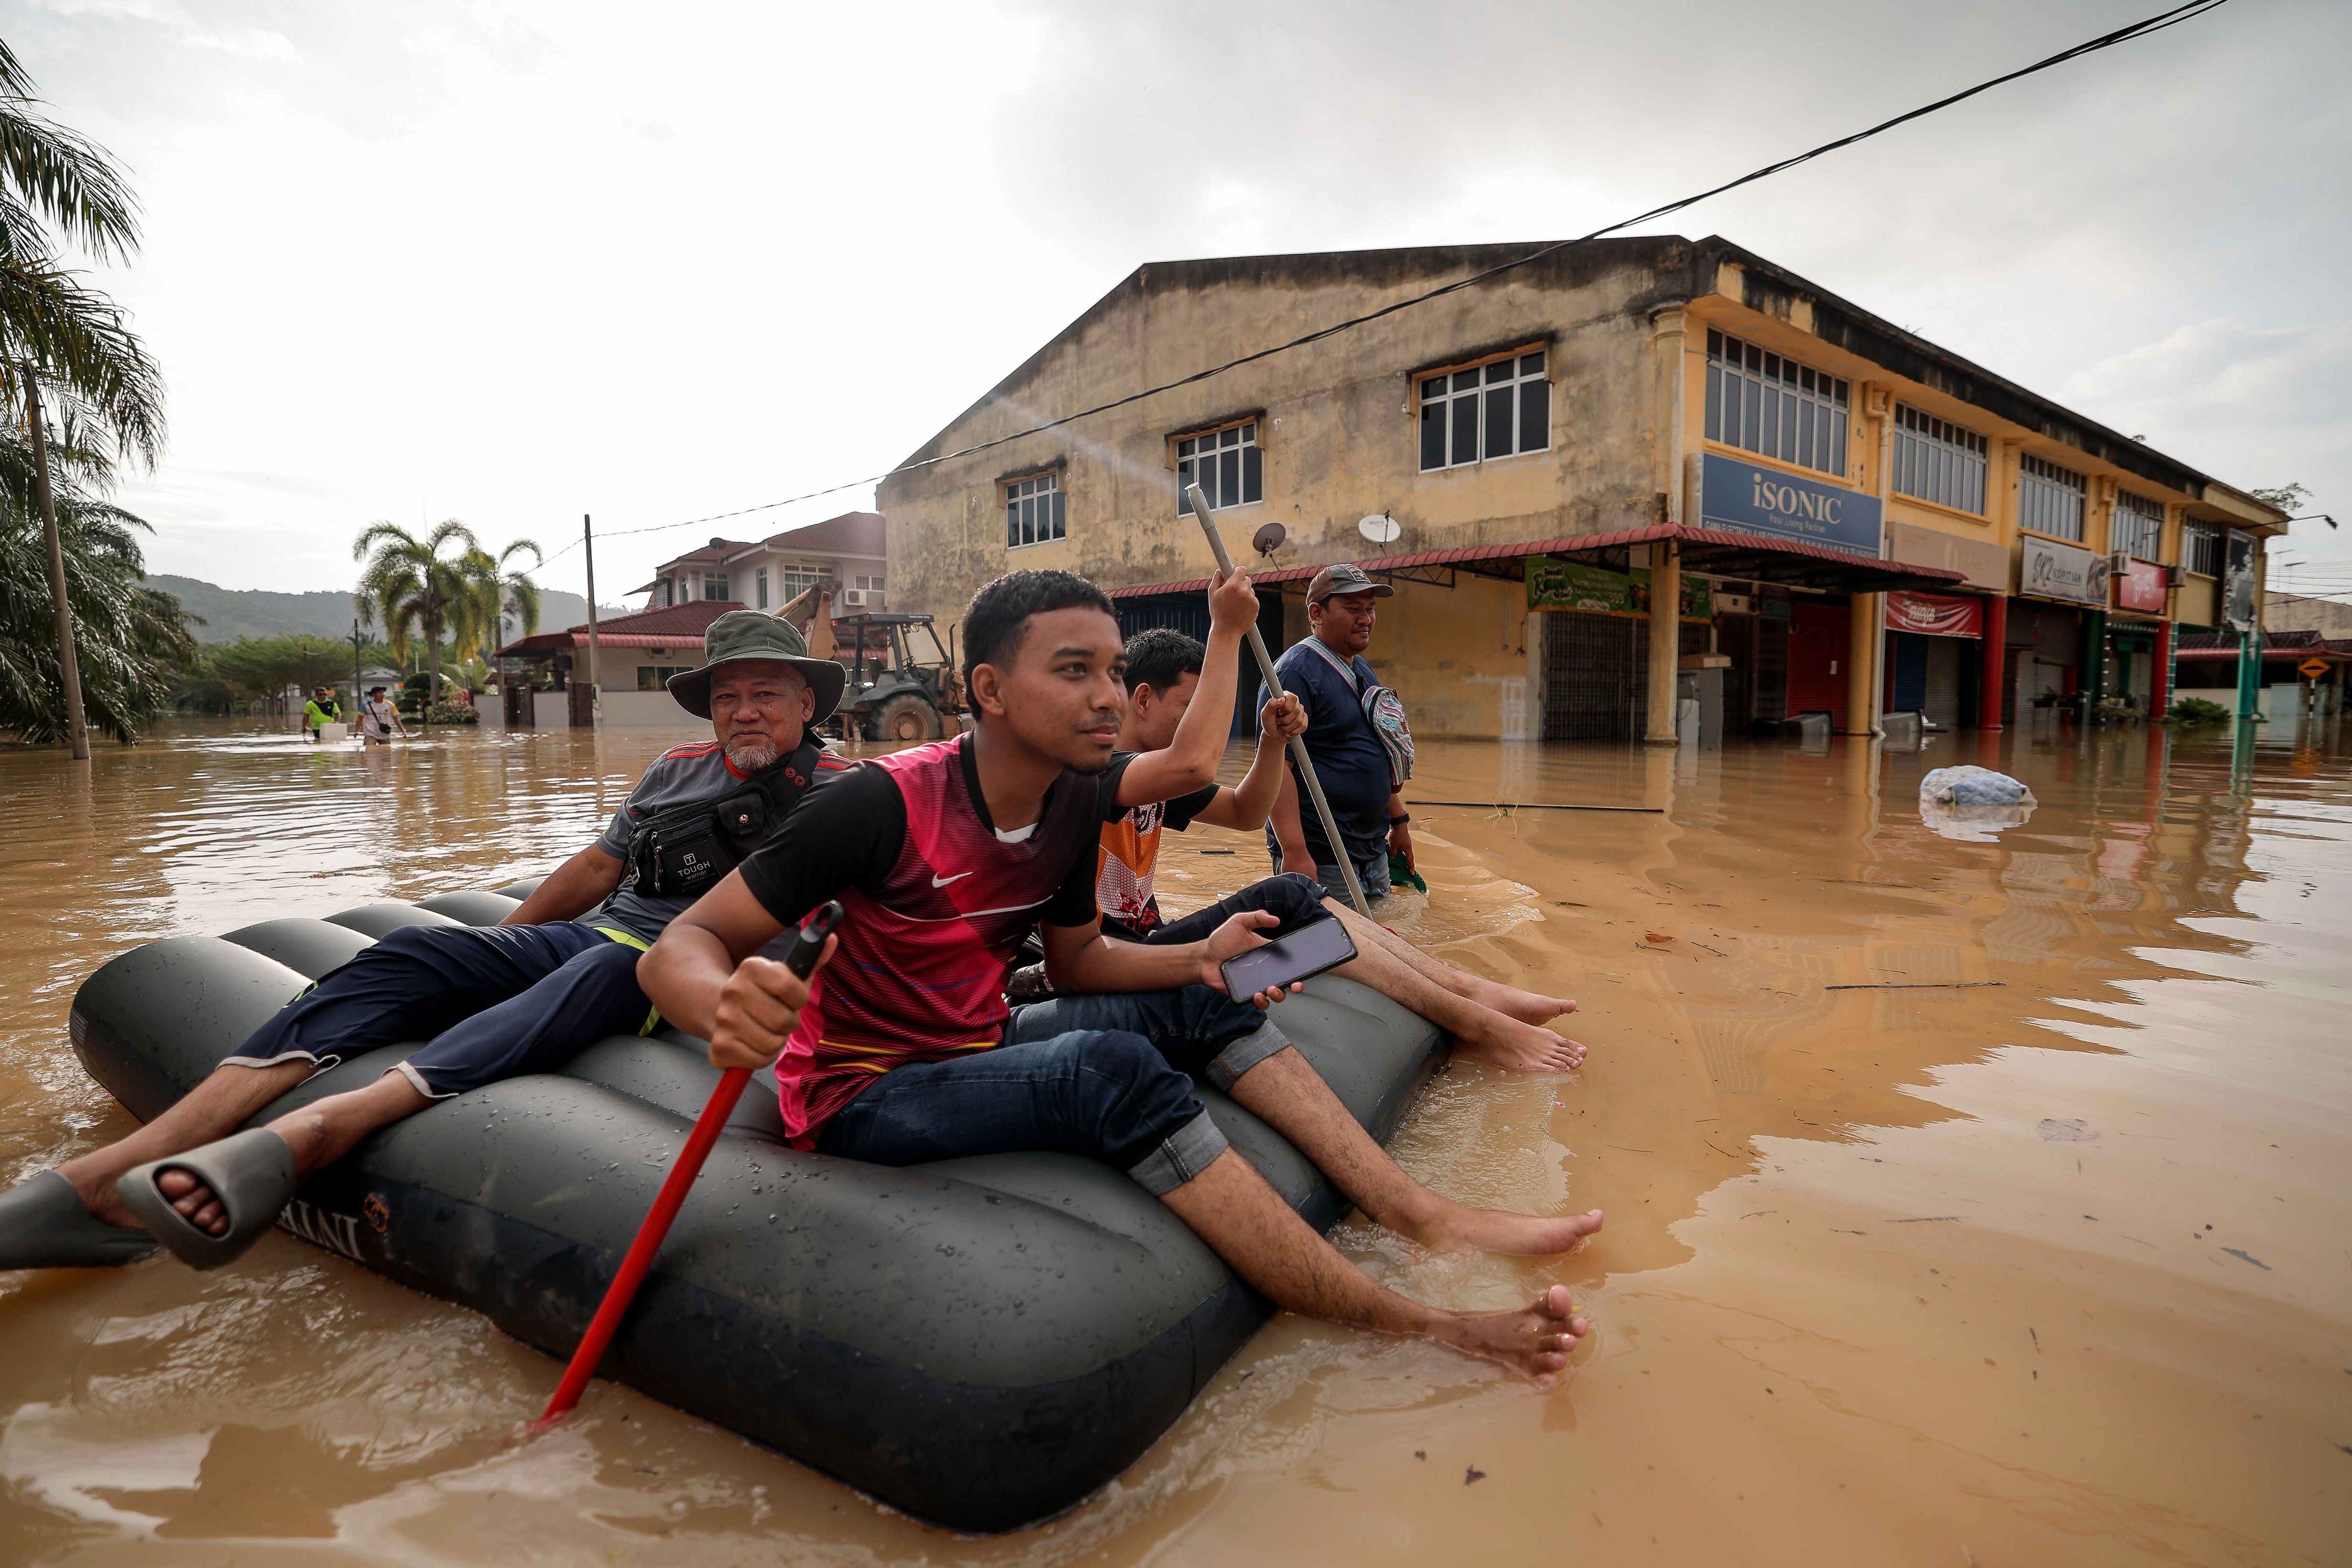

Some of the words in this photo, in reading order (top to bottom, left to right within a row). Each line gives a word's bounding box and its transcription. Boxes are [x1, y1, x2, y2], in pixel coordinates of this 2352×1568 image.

[1752, 472, 1842, 524] iSONIC
[1804, 521, 1827, 533] Partner
[677, 861, 710, 876] TOUGH
[686, 870, 707, 880] warrior
